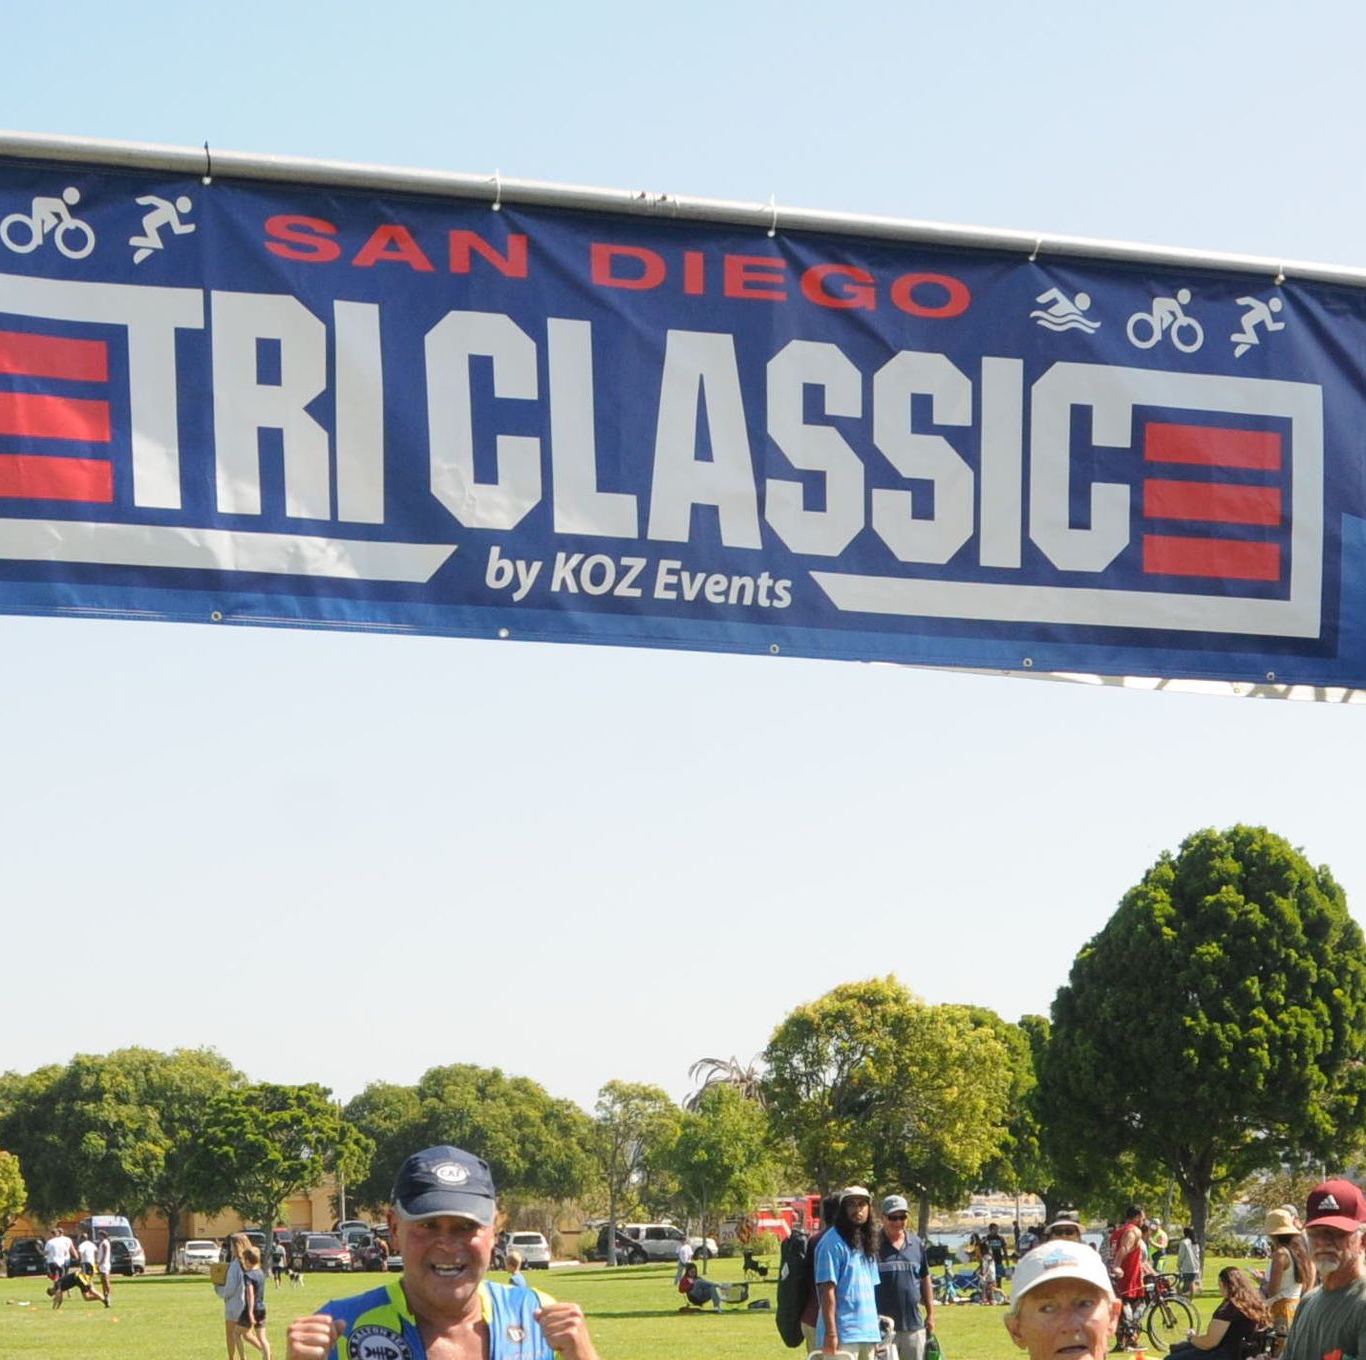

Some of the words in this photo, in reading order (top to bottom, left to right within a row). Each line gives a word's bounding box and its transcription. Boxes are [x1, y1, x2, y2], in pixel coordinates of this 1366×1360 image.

[263, 212, 529, 280] SAN
[589, 241, 972, 321] DIEGO
[123, 286, 385, 524] TRI
[424, 309, 1132, 573] CLASSIC
[485, 546, 543, 602] by
[550, 551, 647, 599] KOZ
[653, 558, 793, 609] Events
